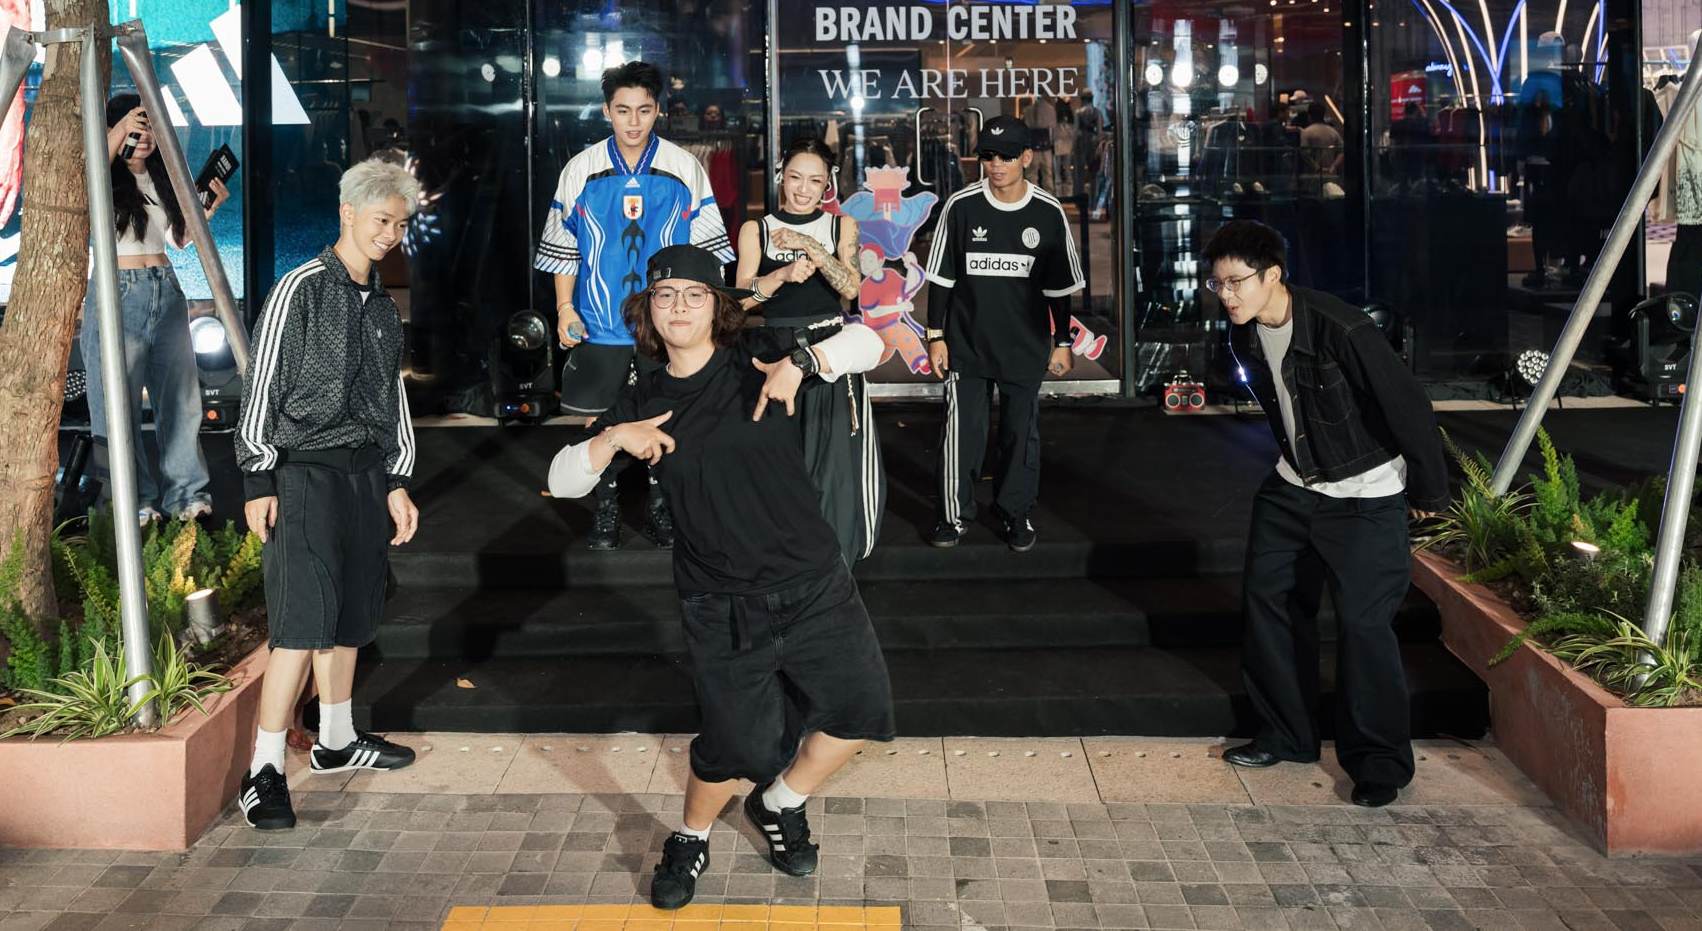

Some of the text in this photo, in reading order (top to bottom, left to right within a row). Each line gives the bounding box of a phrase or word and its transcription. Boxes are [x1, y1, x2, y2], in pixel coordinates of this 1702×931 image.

[815, 5, 1078, 42] BRAND CENTER
[817, 67, 1079, 100] WE ARE HERE
[969, 257, 1019, 272] adidas
